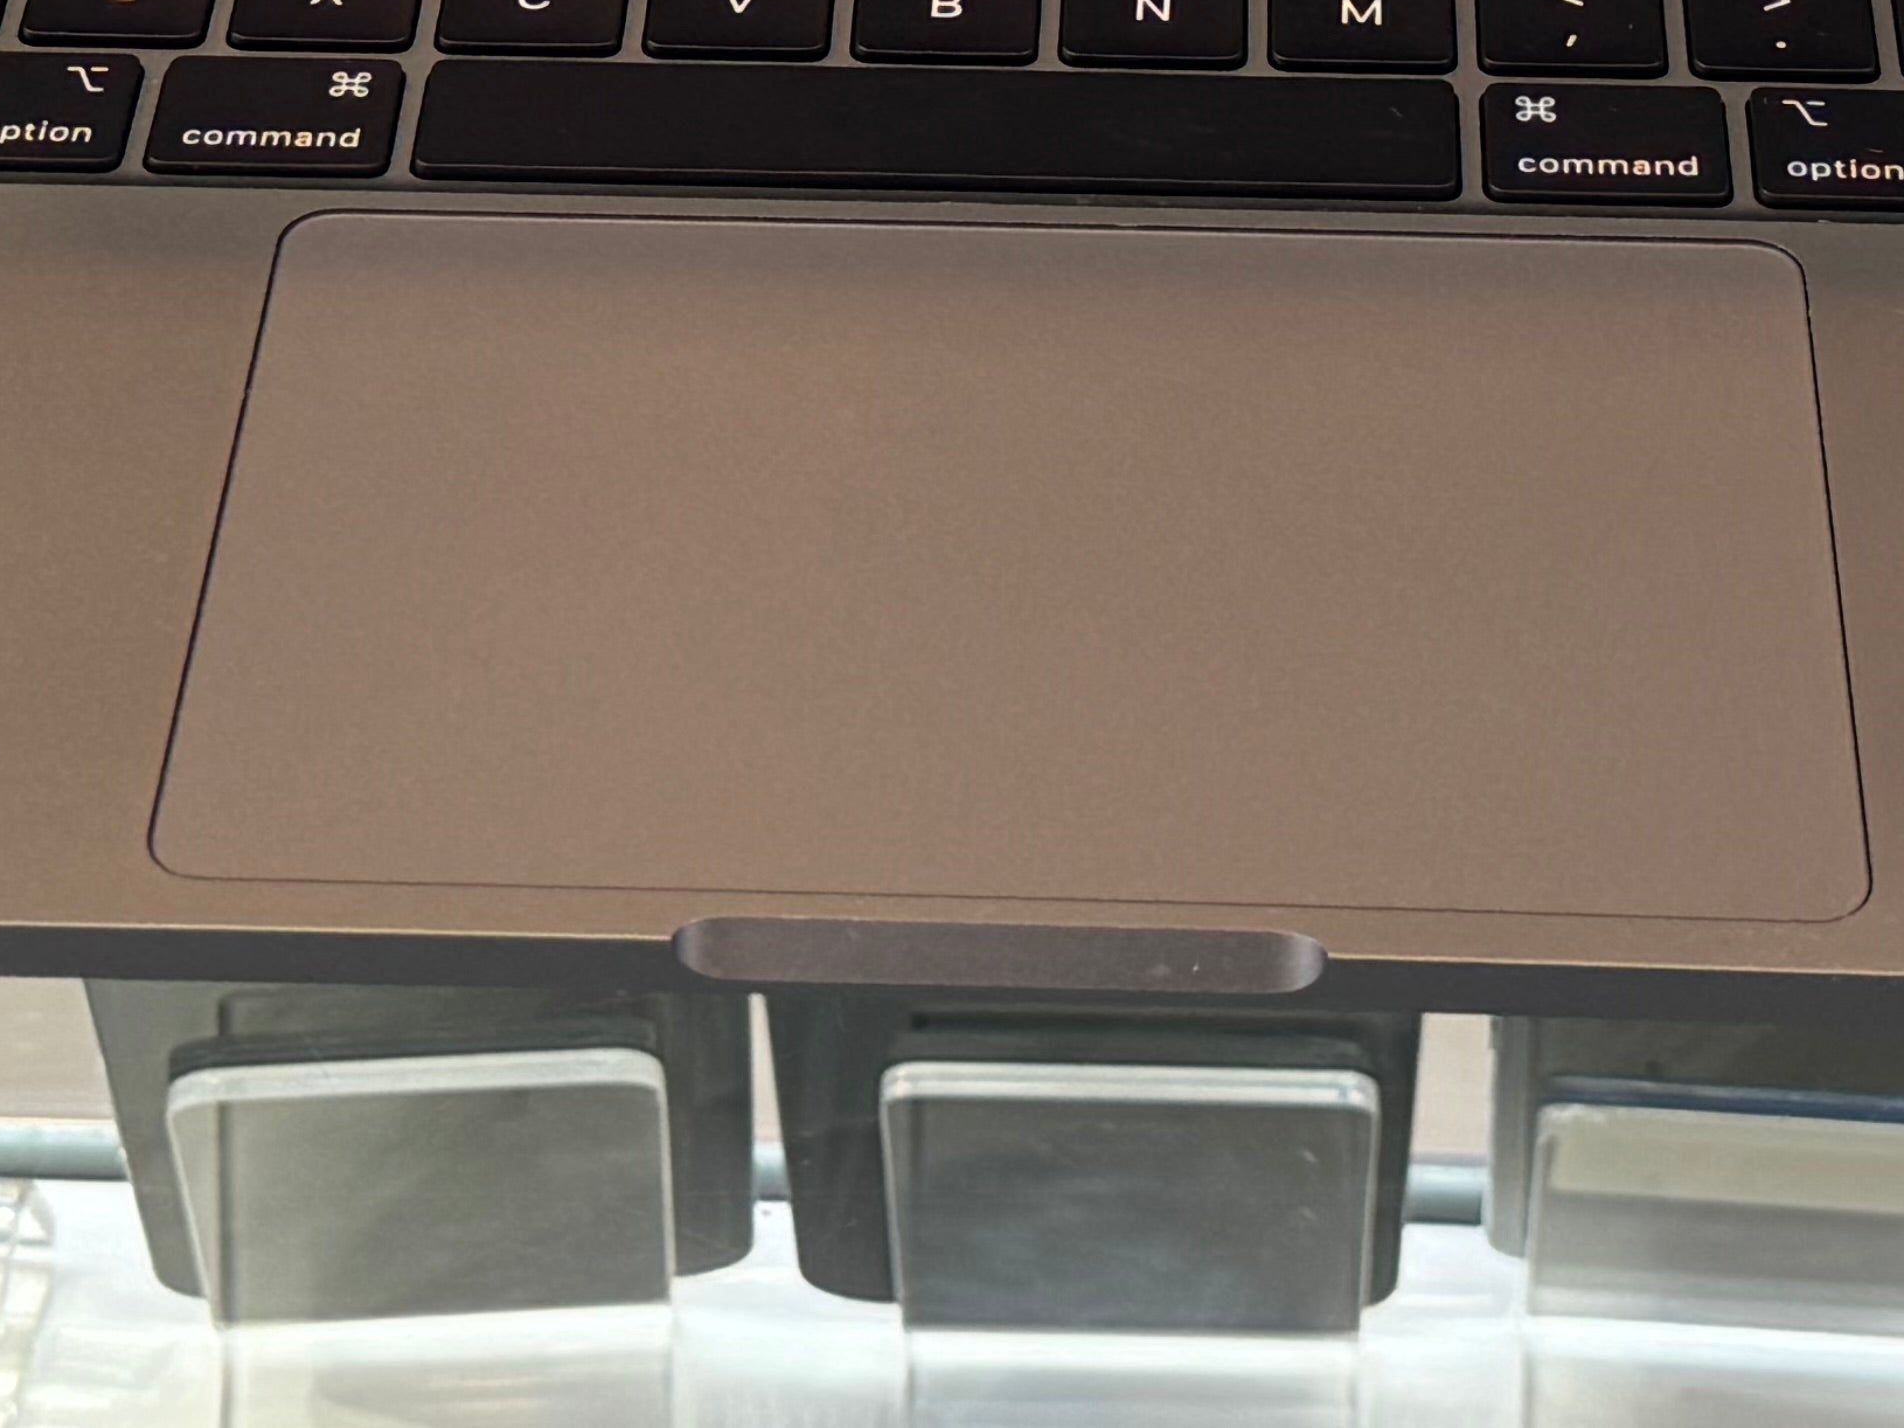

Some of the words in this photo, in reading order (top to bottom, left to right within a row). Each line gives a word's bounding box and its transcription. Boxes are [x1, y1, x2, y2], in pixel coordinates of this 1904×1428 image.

[182, 127, 361, 148] command
[1518, 155, 1699, 176] command
[1787, 158, 1904, 181] option
